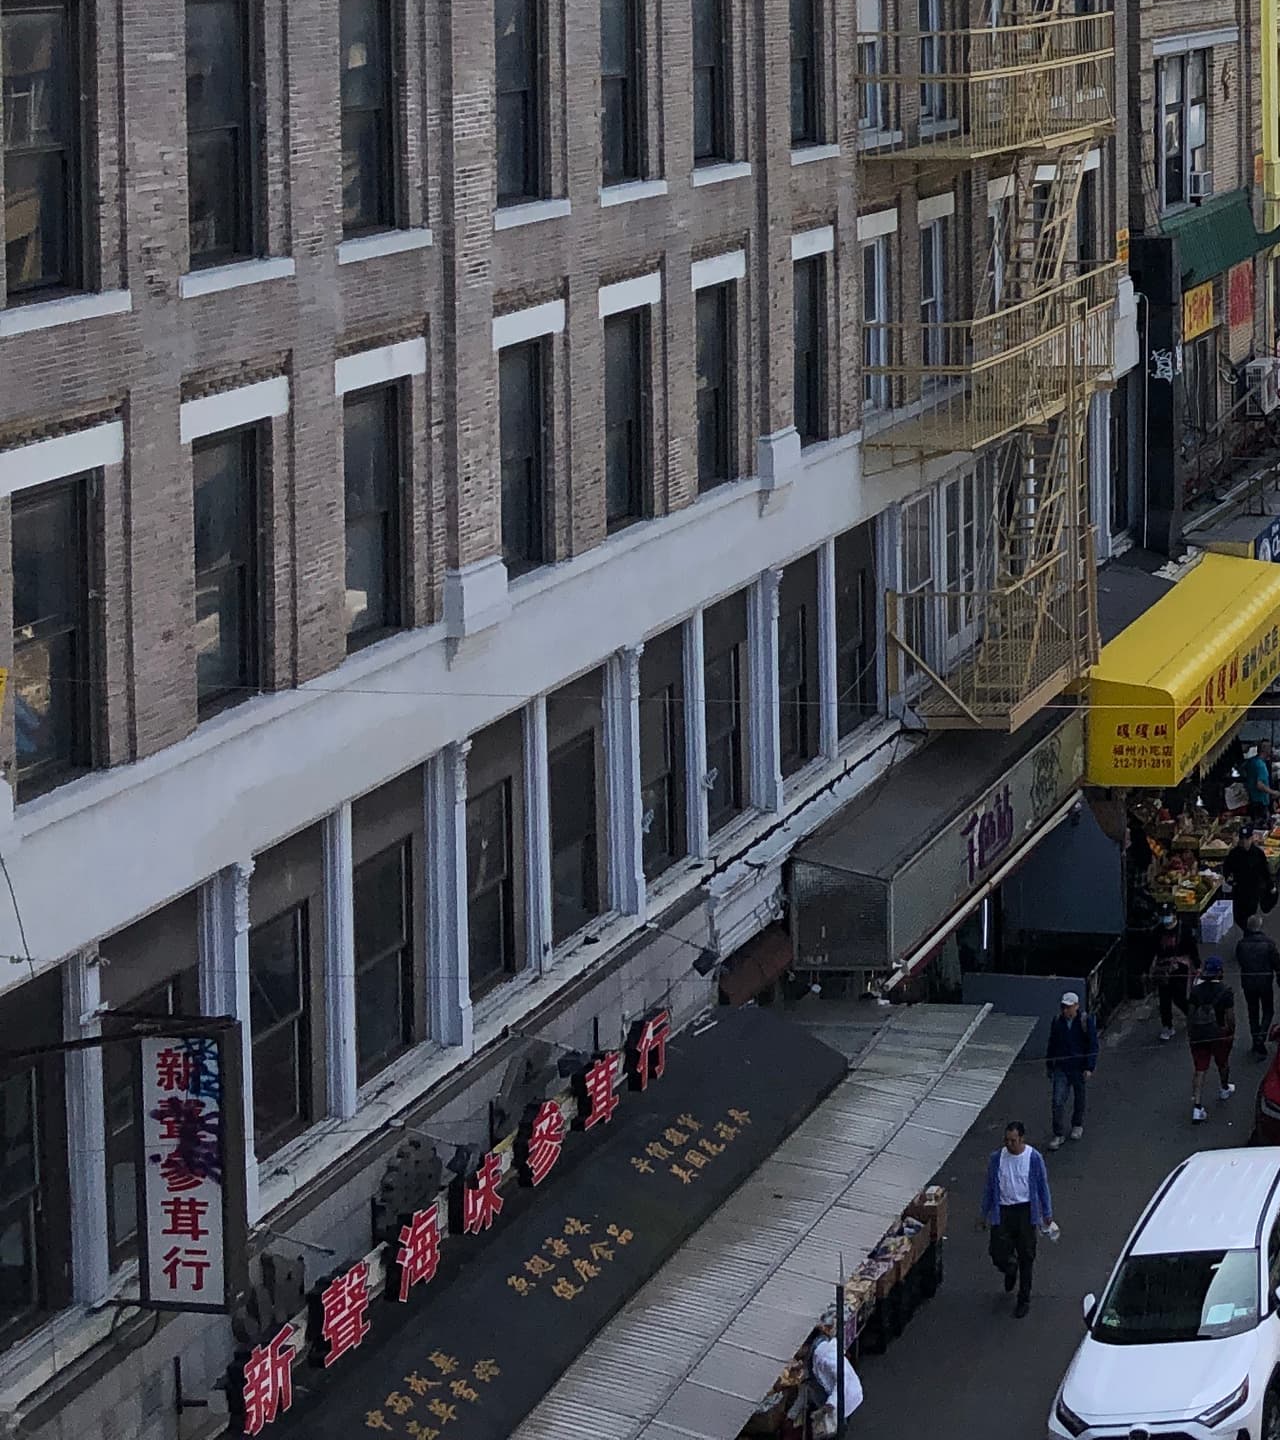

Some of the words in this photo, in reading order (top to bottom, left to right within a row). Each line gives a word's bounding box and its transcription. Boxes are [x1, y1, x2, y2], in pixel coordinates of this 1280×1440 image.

[243, 1010, 671, 1436] 新聲海味參茸行
